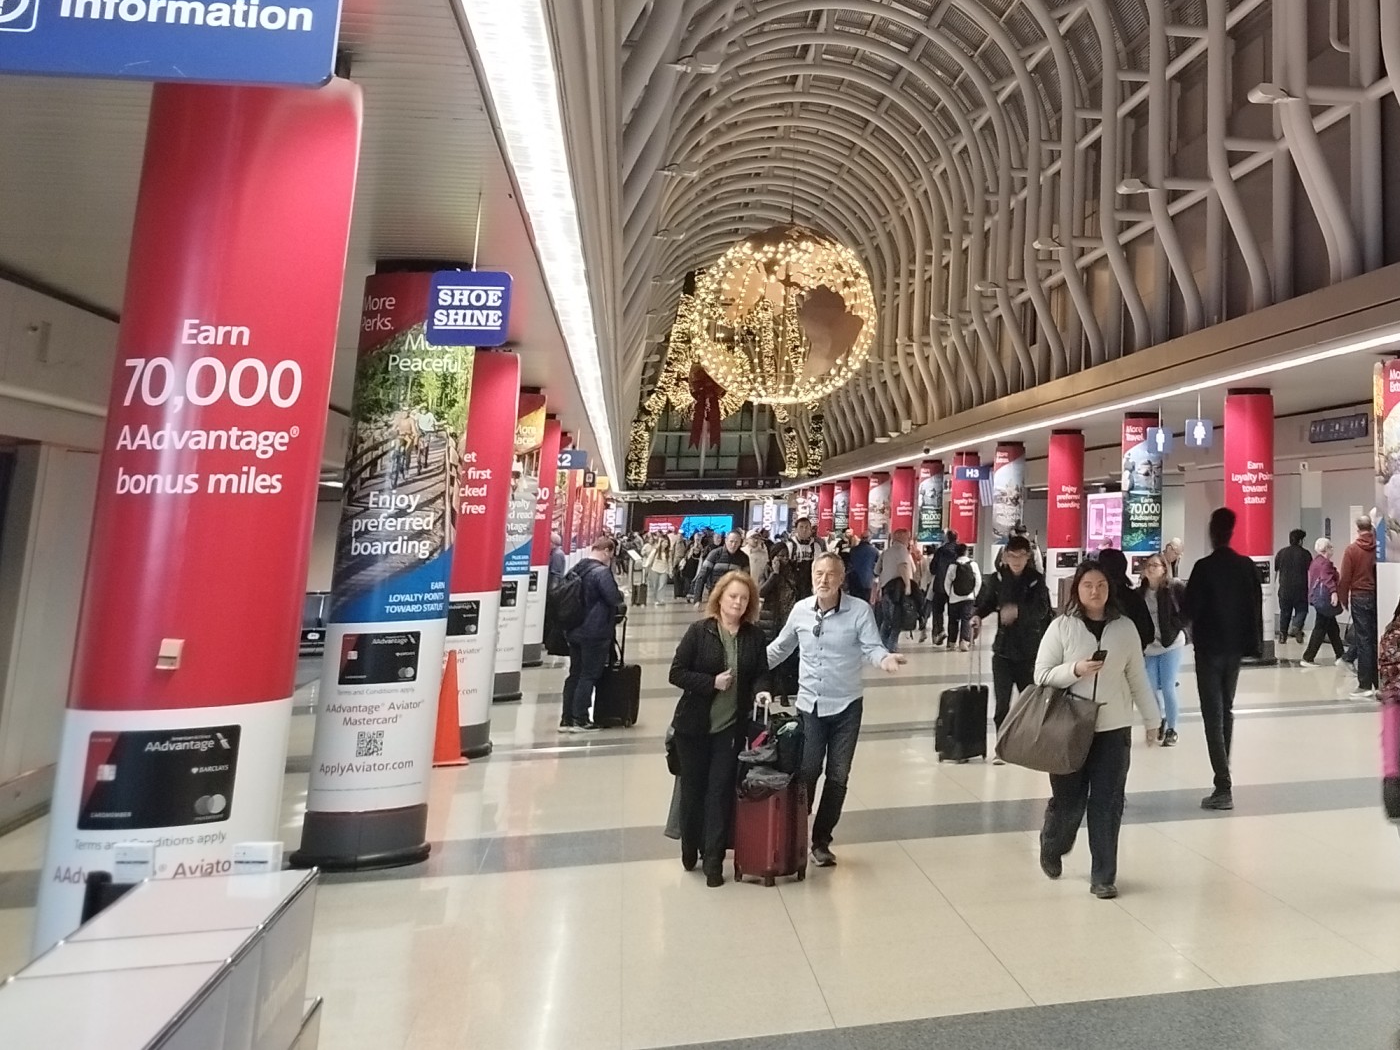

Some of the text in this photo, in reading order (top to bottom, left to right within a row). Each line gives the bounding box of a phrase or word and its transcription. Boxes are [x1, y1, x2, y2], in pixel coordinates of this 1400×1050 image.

[437, 289, 503, 307] SHOE
[433, 309, 503, 326] SHINE
[181, 319, 250, 346] Earn
[122, 356, 302, 413] 70,000
[1247, 460, 1264, 469] Earn
[467, 467, 492, 480] first
[965, 468, 980, 478] H3
[1231, 472, 1257, 483] Loyalty
[115, 467, 283, 496] bonus miles
[459, 484, 488, 497] cked
[1242, 484, 1267, 493] toward
[369, 490, 421, 512] Enjoy
[461, 502, 487, 515] free
[1129, 503, 1161, 515] 70,000
[351, 512, 434, 537] preferred
[350, 535, 431, 559] boarding
[388, 593, 423, 603] LOYALTY
[384, 605, 423, 614] TOWARD
[144, 740, 215, 752] AAdvantage
[198, 764, 229, 773] BARCLAYS
[319, 759, 414, 777] ApplyAviator.com
[74, 839, 102, 851] Terms
[171, 857, 232, 879] Aviato
